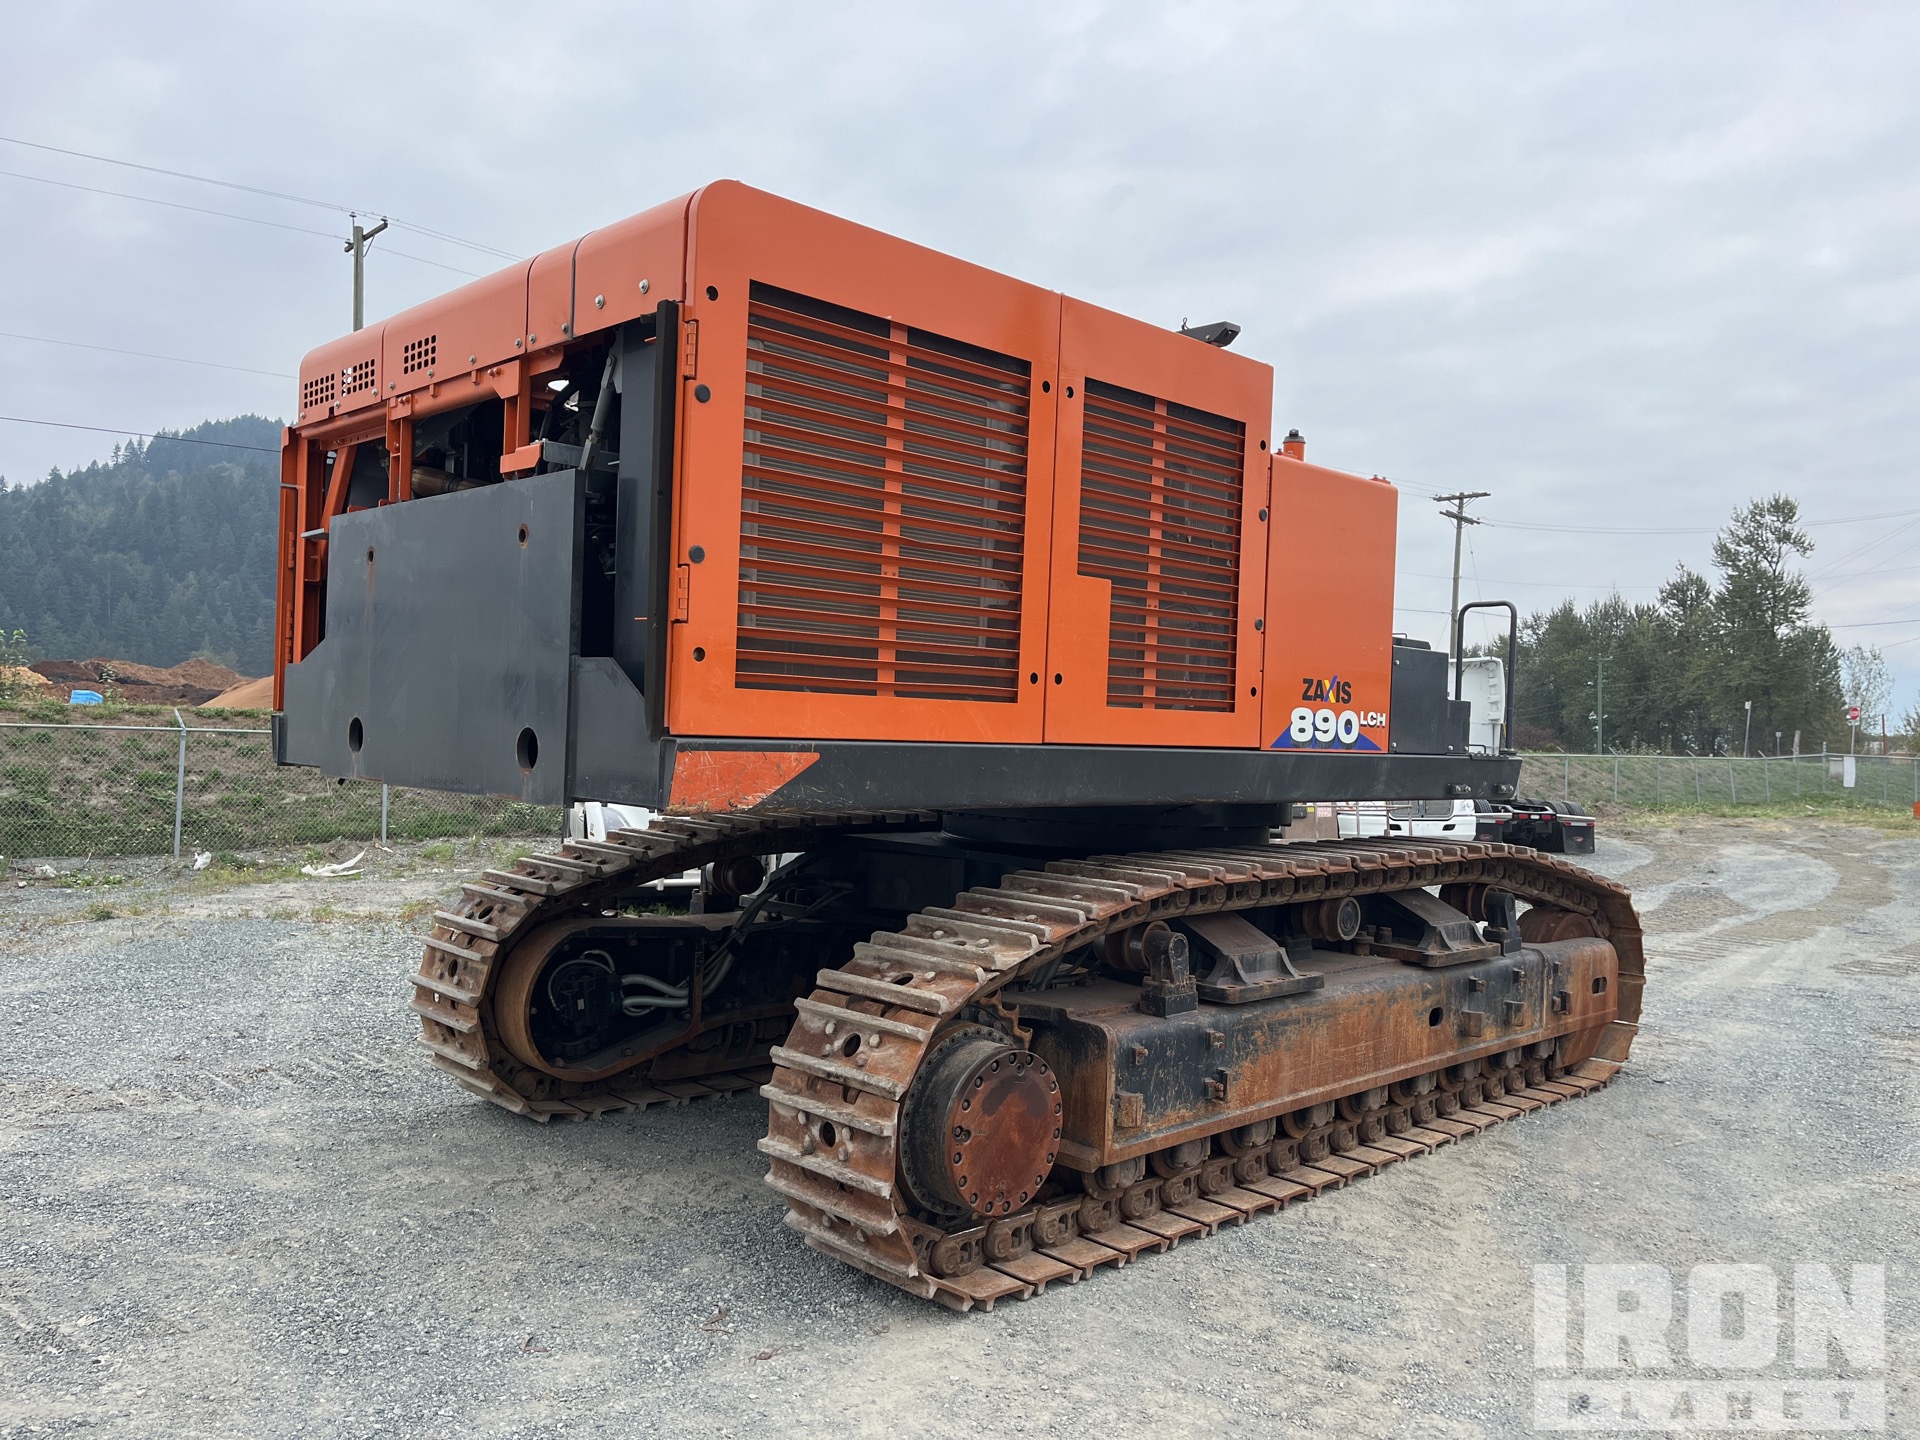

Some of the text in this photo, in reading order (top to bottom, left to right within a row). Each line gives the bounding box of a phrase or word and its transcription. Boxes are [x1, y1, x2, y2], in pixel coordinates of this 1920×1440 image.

[1302, 676, 1352, 704] ZAXIS
[1290, 707, 1386, 745] 890 LCH
